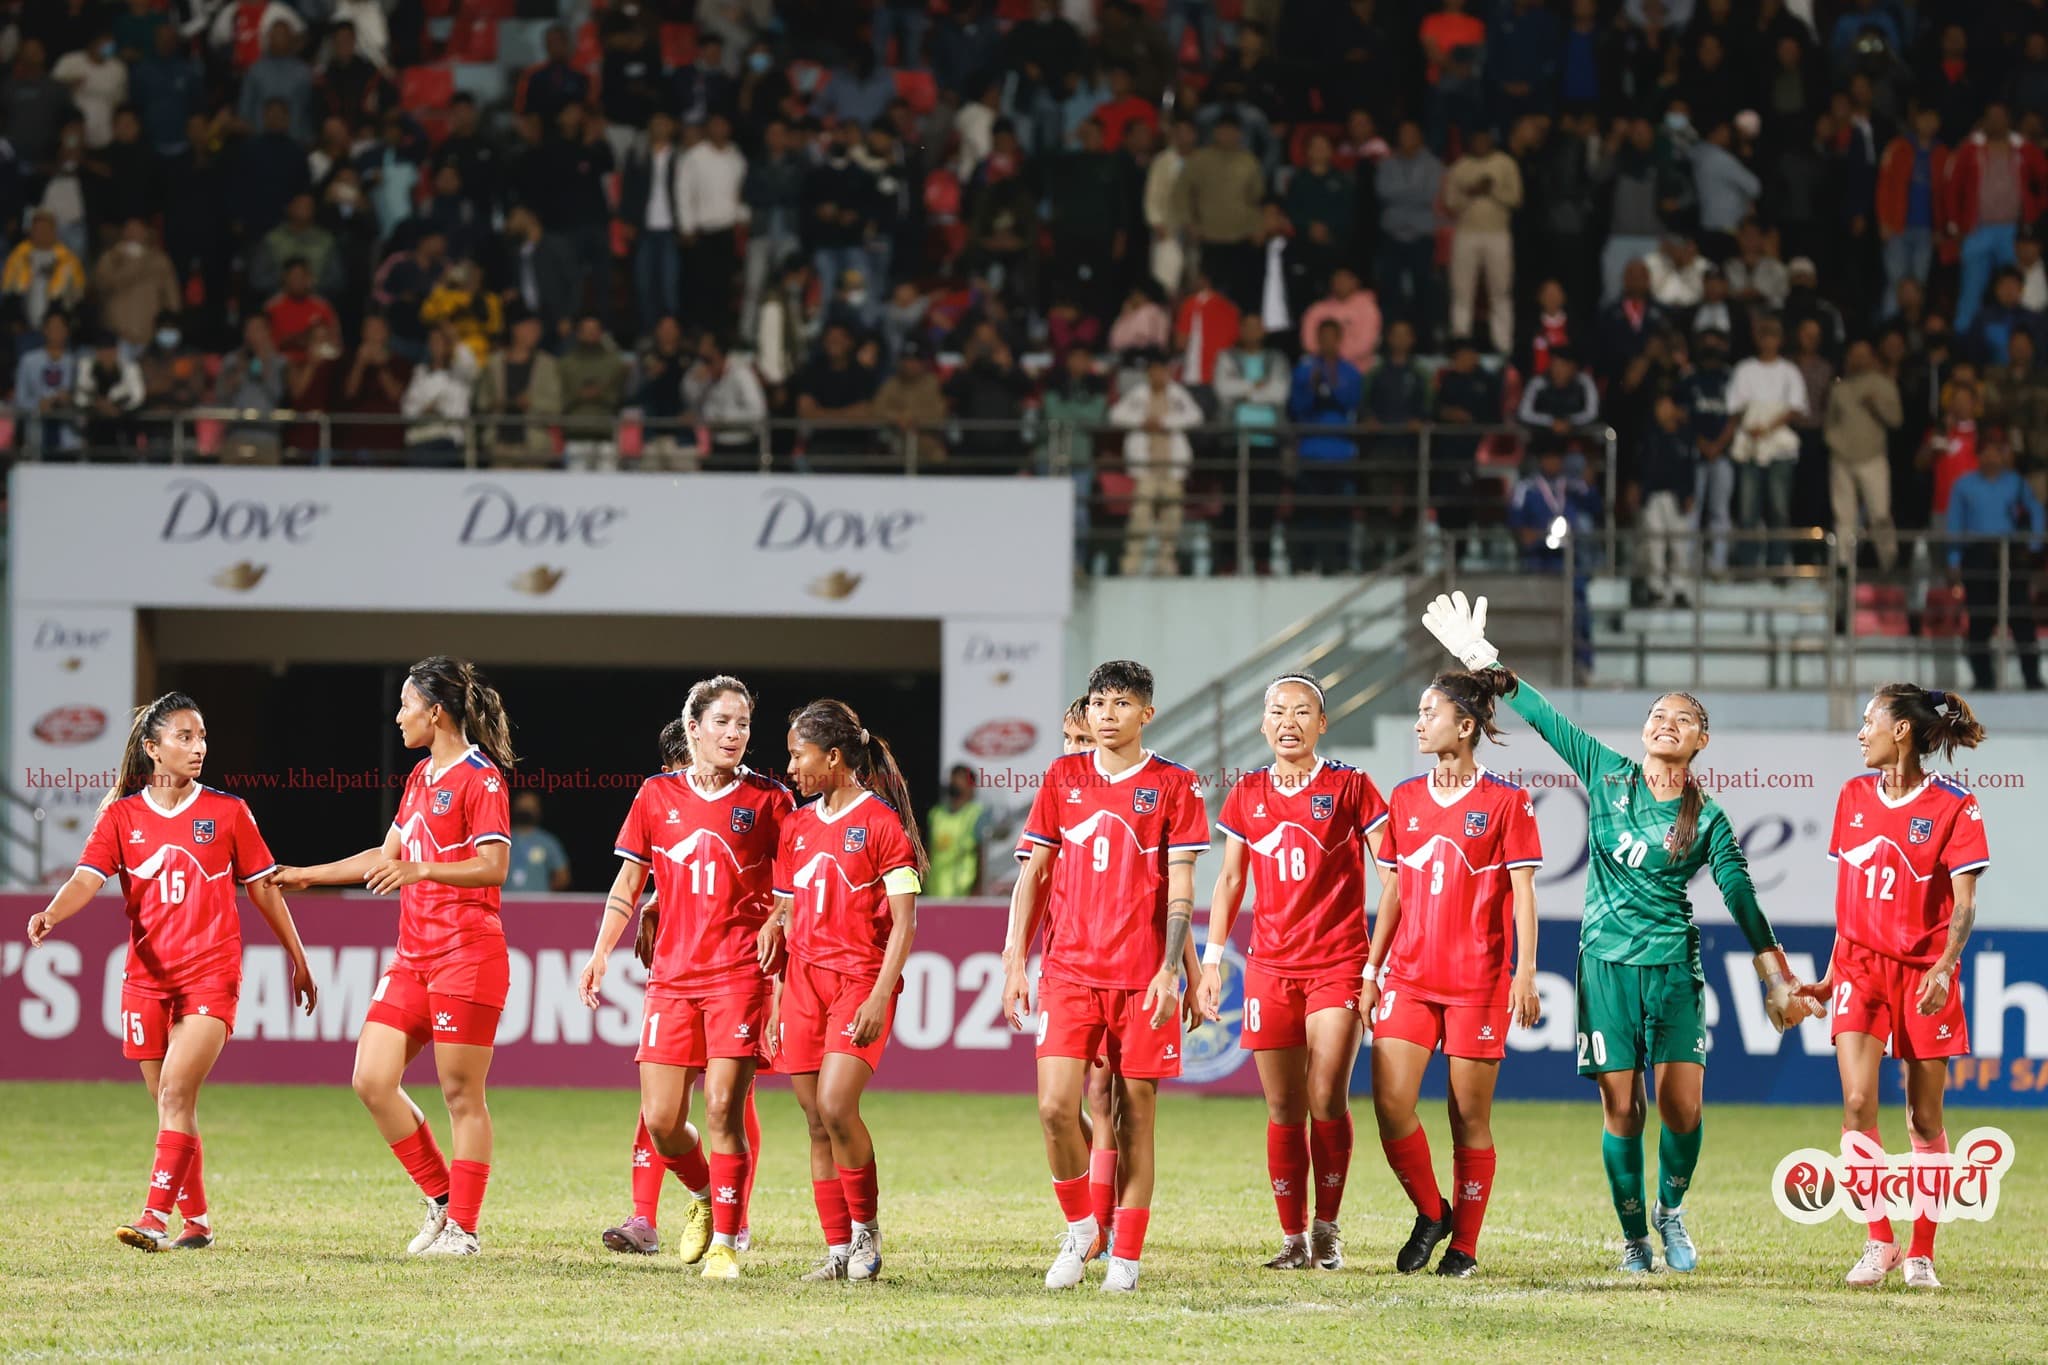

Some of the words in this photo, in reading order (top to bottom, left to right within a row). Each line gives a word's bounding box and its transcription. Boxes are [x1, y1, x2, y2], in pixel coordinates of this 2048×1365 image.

[160, 479, 320, 543] Dove
[457, 482, 617, 548] Dove
[755, 487, 915, 553] Dove
[33, 618, 108, 651] Dove
[962, 634, 1037, 665] Dove
[1092, 836, 1109, 873] 9
[1274, 847, 1306, 882] 18
[1612, 832, 1647, 869] 20
[159, 870, 186, 905] 15
[689, 859, 716, 896] 11
[1430, 860, 1445, 896] 3
[1864, 864, 1896, 901] 12
[1243, 997, 1259, 1032] 18
[1380, 990, 1397, 1021] 3
[1832, 981, 1851, 1018] 12
[121, 1010, 144, 1046] 15
[1577, 1031, 1606, 1066] 20
